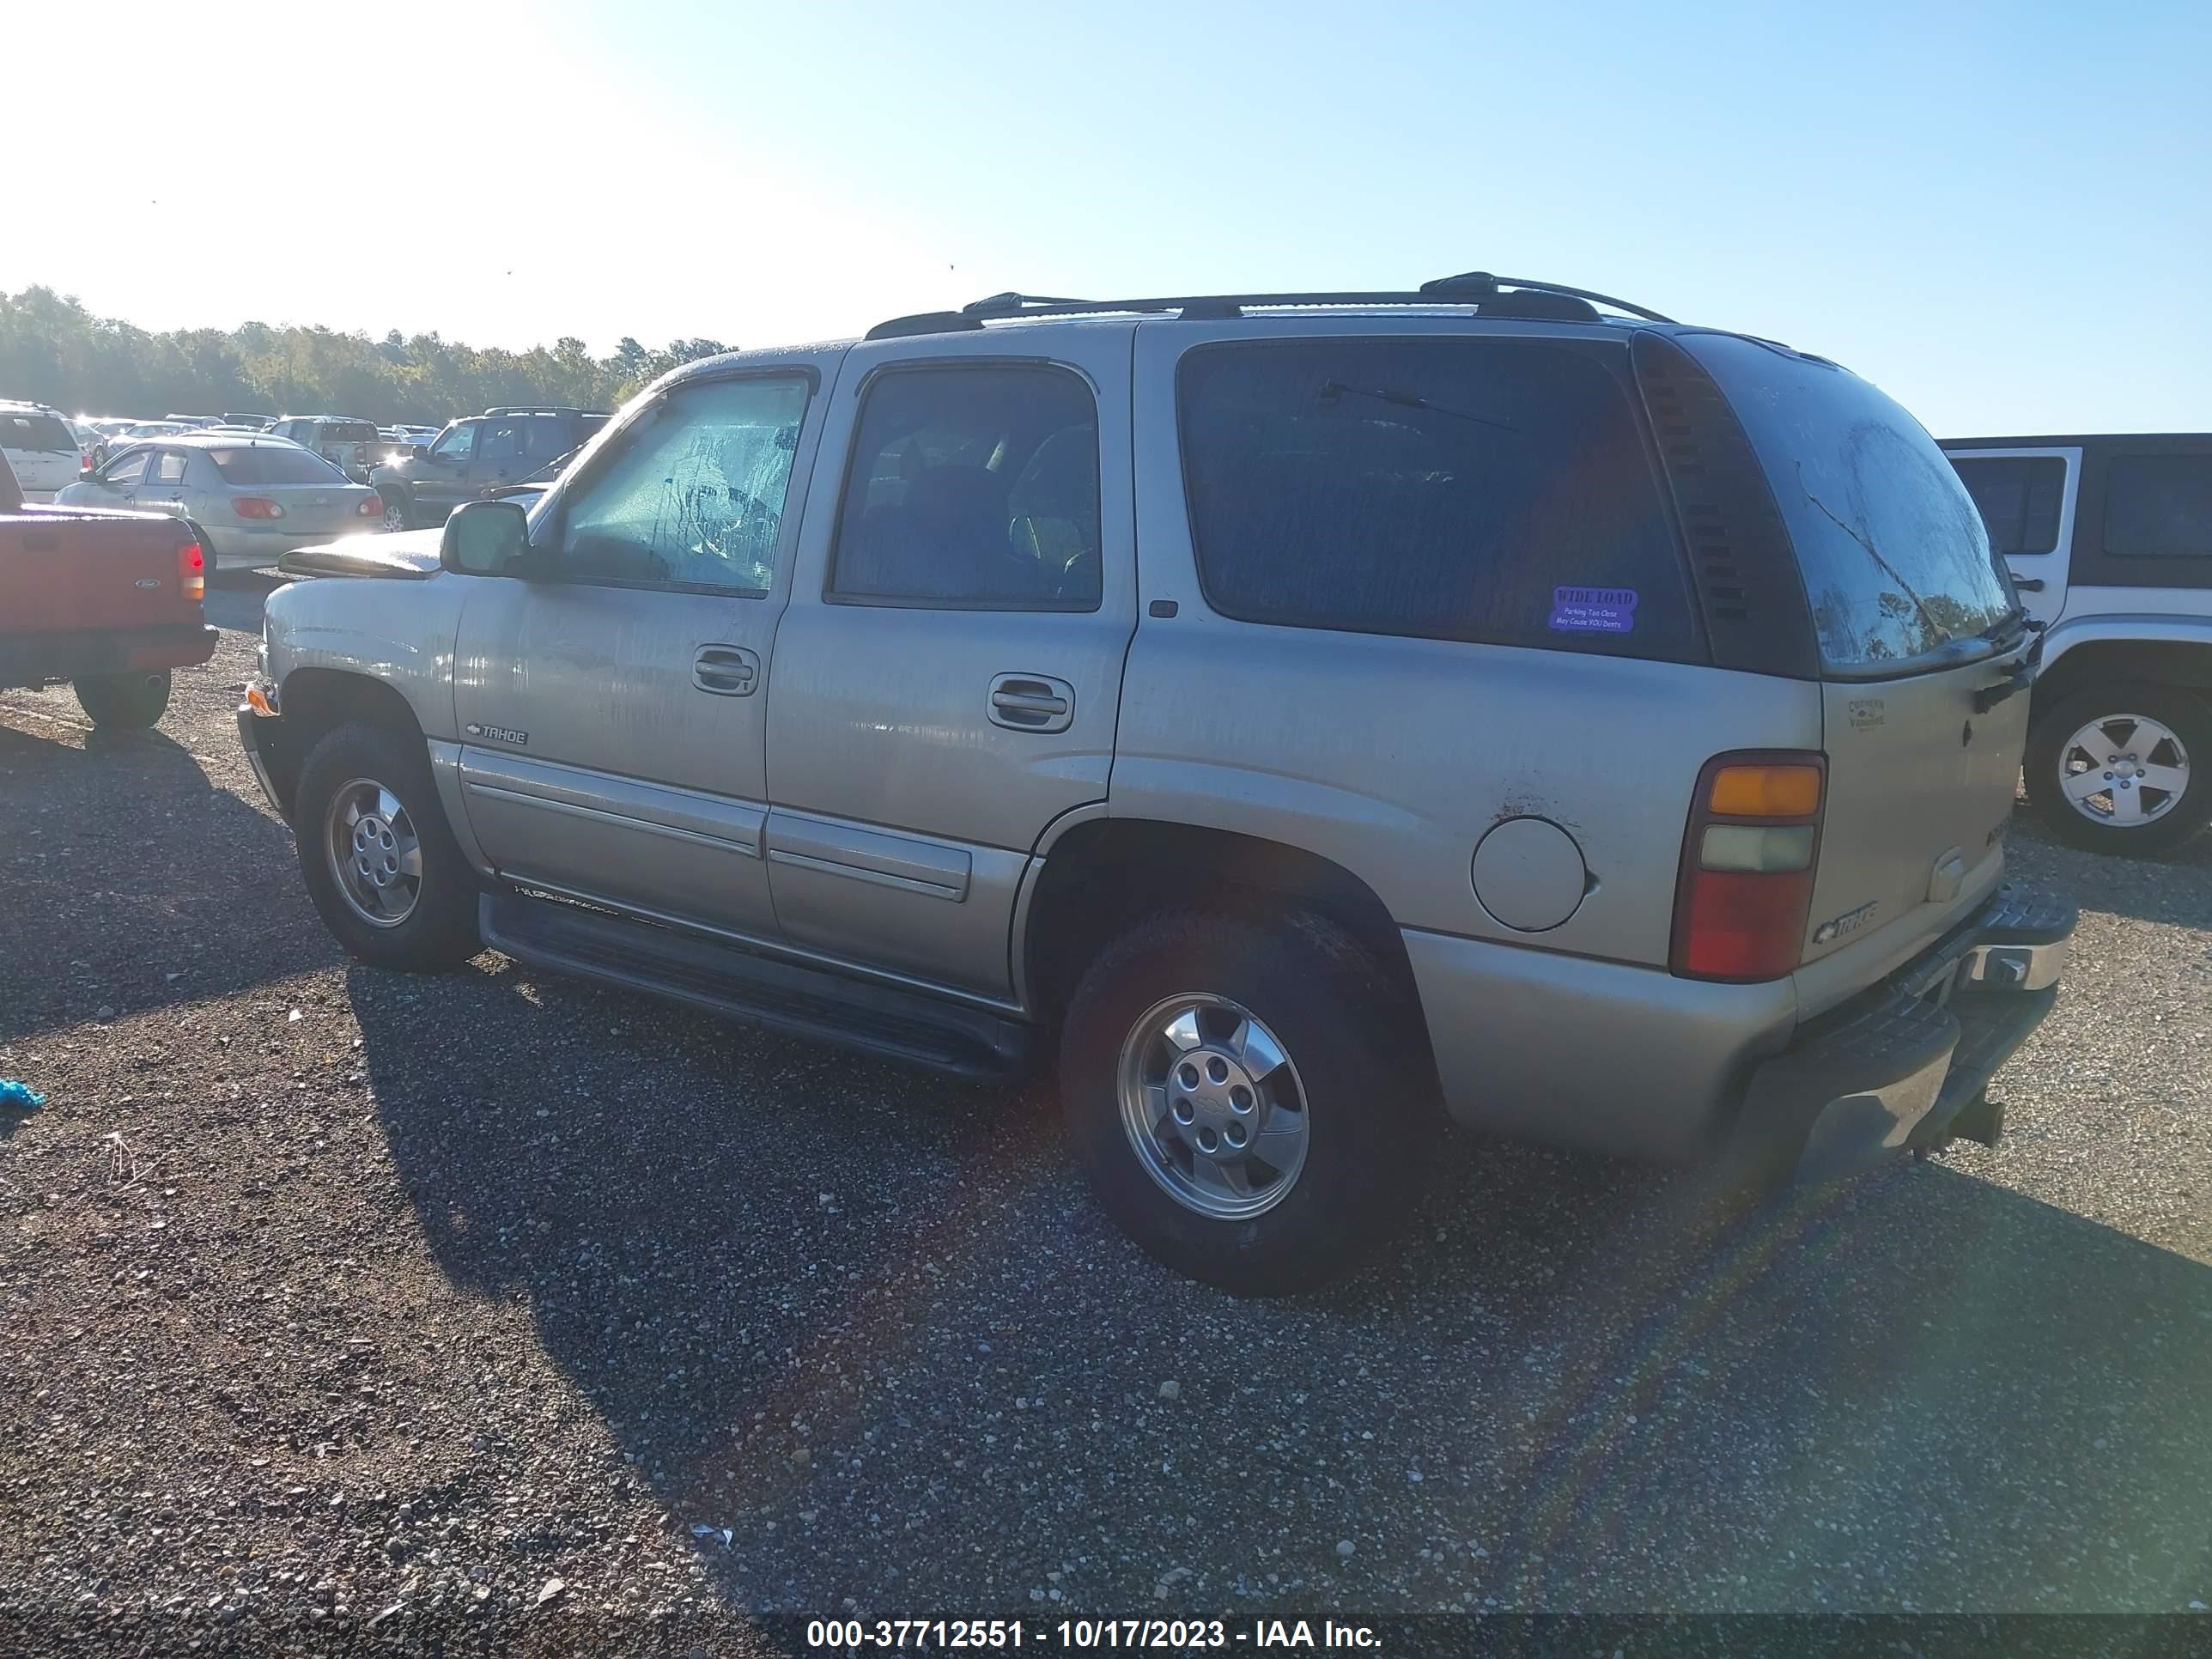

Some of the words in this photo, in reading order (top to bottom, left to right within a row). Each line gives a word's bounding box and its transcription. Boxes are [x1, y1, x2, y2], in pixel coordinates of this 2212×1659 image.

[1558, 590, 1594, 602] WIDE
[1597, 591, 1633, 605] LOAD
[1564, 607, 1587, 617] Parking
[1556, 617, 1569, 626] May
[1570, 617, 1588, 626] Cause
[1603, 620, 1621, 629] Dents
[482, 726, 526, 744] TAHOE
